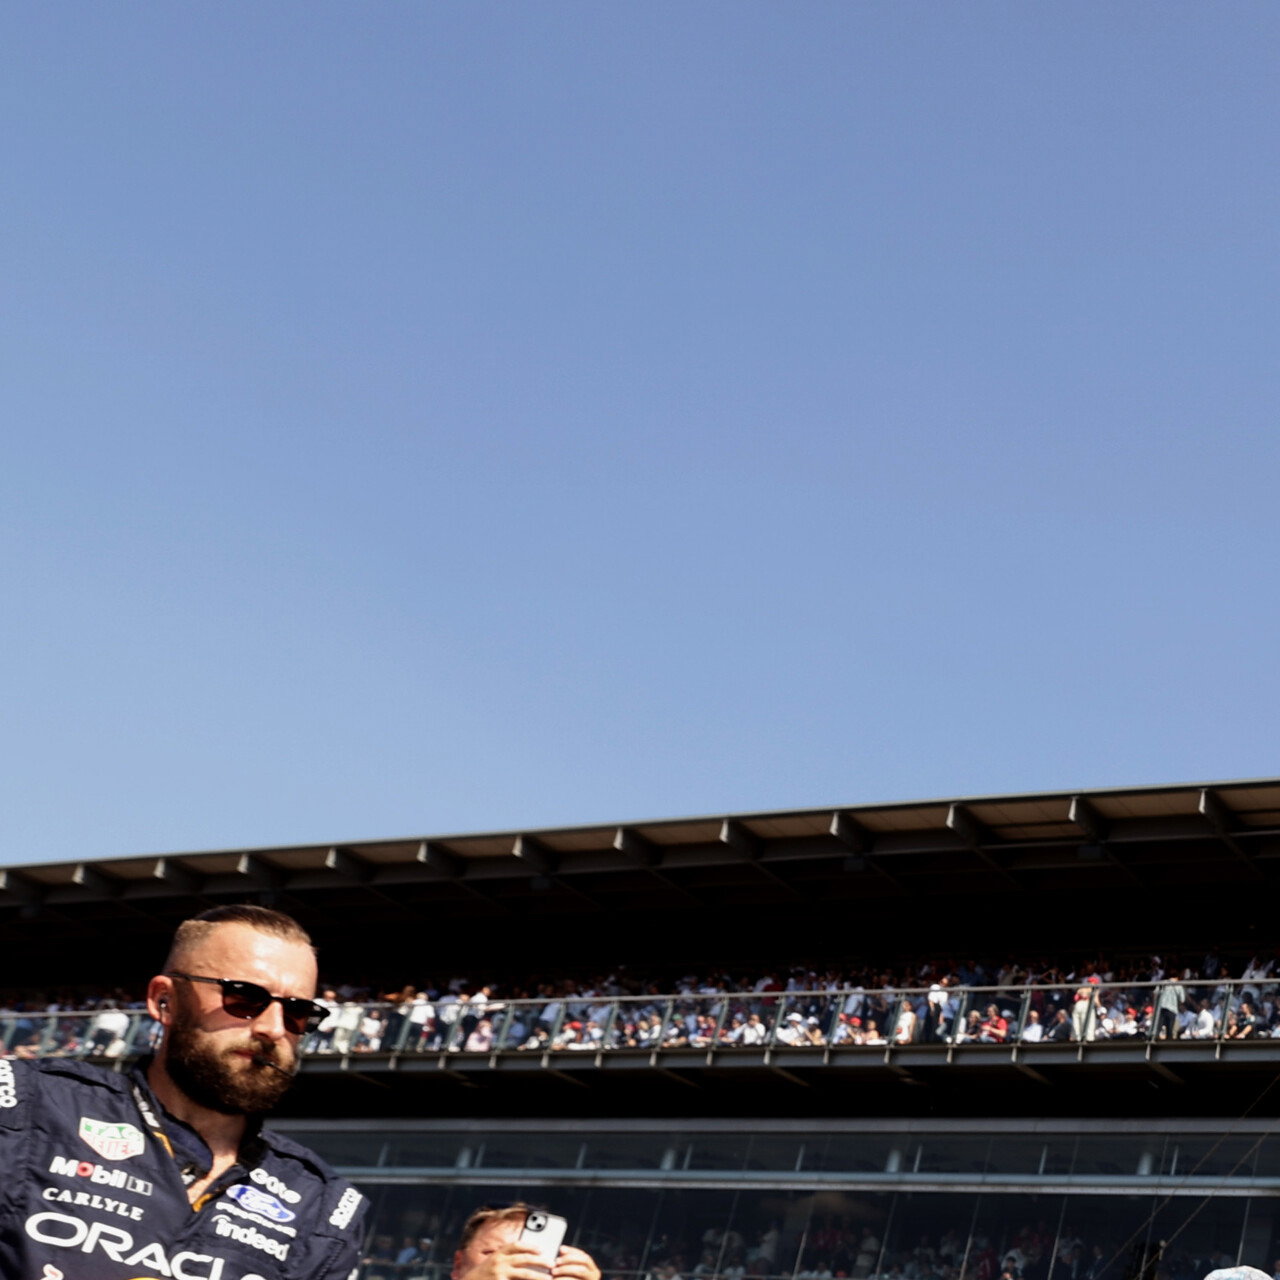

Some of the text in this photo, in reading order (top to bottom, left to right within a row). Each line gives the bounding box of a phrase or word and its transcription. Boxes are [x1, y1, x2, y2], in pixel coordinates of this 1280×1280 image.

[49, 1155, 128, 1189] Mobil
[42, 1186, 145, 1221] CARLYLE
[213, 1216, 290, 1262] indeed
